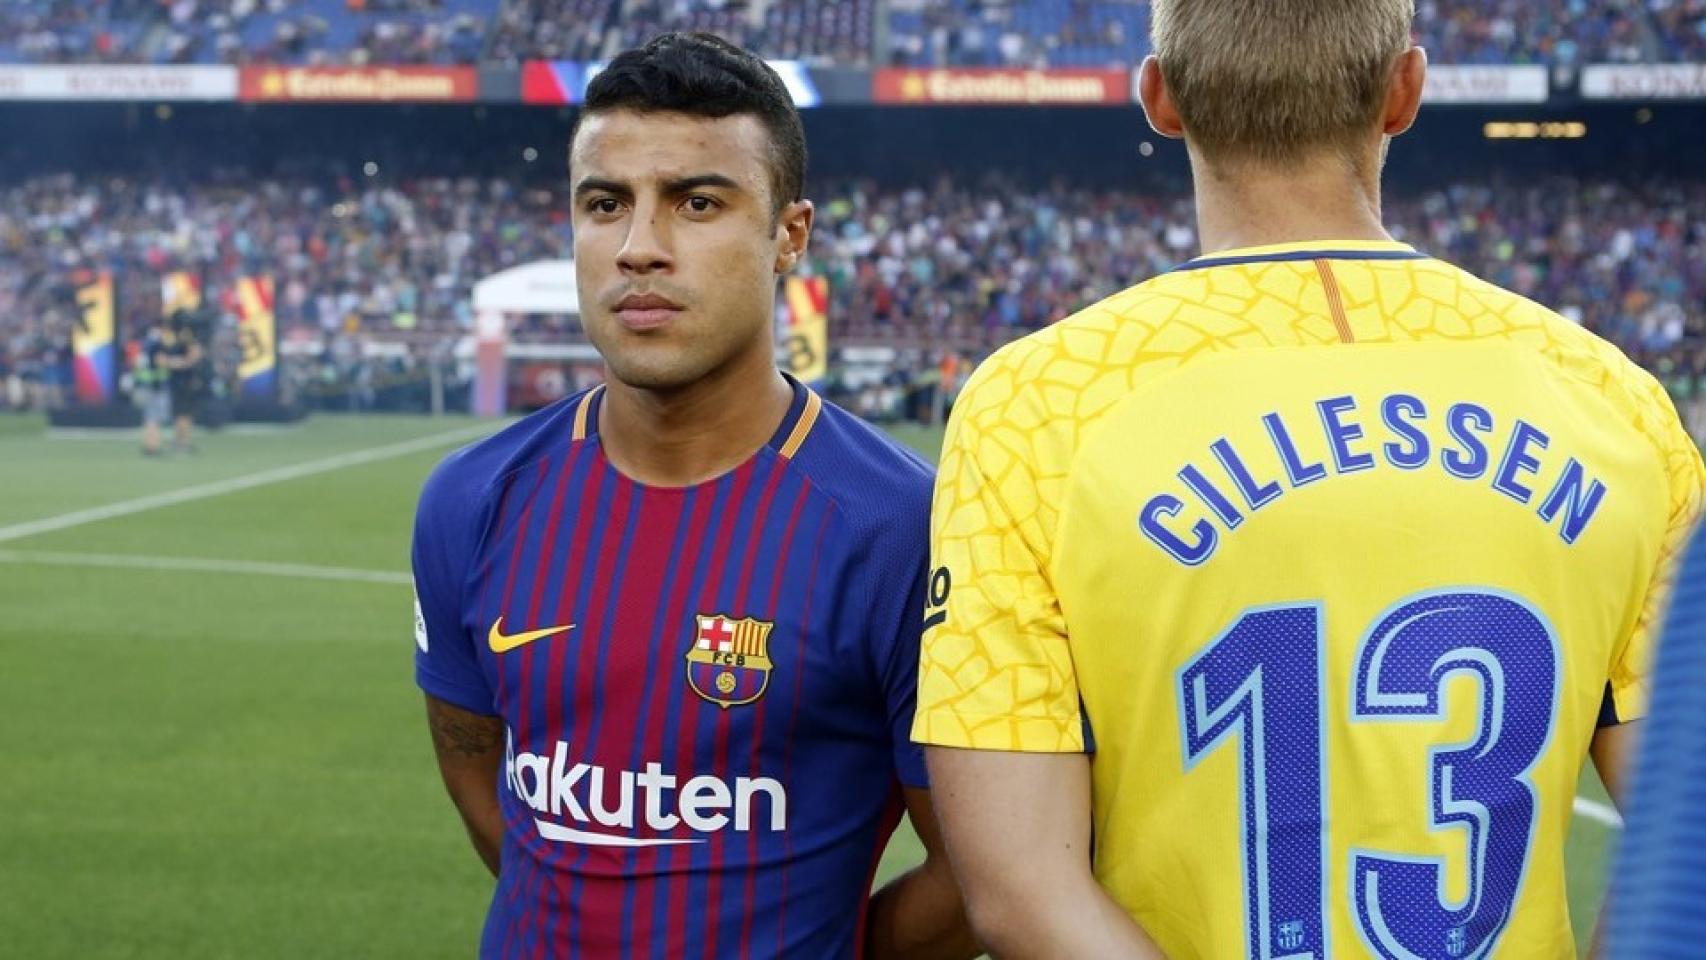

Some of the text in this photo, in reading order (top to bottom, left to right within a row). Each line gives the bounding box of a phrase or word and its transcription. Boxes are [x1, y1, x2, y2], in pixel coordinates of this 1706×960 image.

[1138, 393, 1607, 567] CILLESSEN
[712, 651, 746, 666] FCB
[505, 726, 787, 832] Rakuten
[1174, 585, 1562, 960] 13
